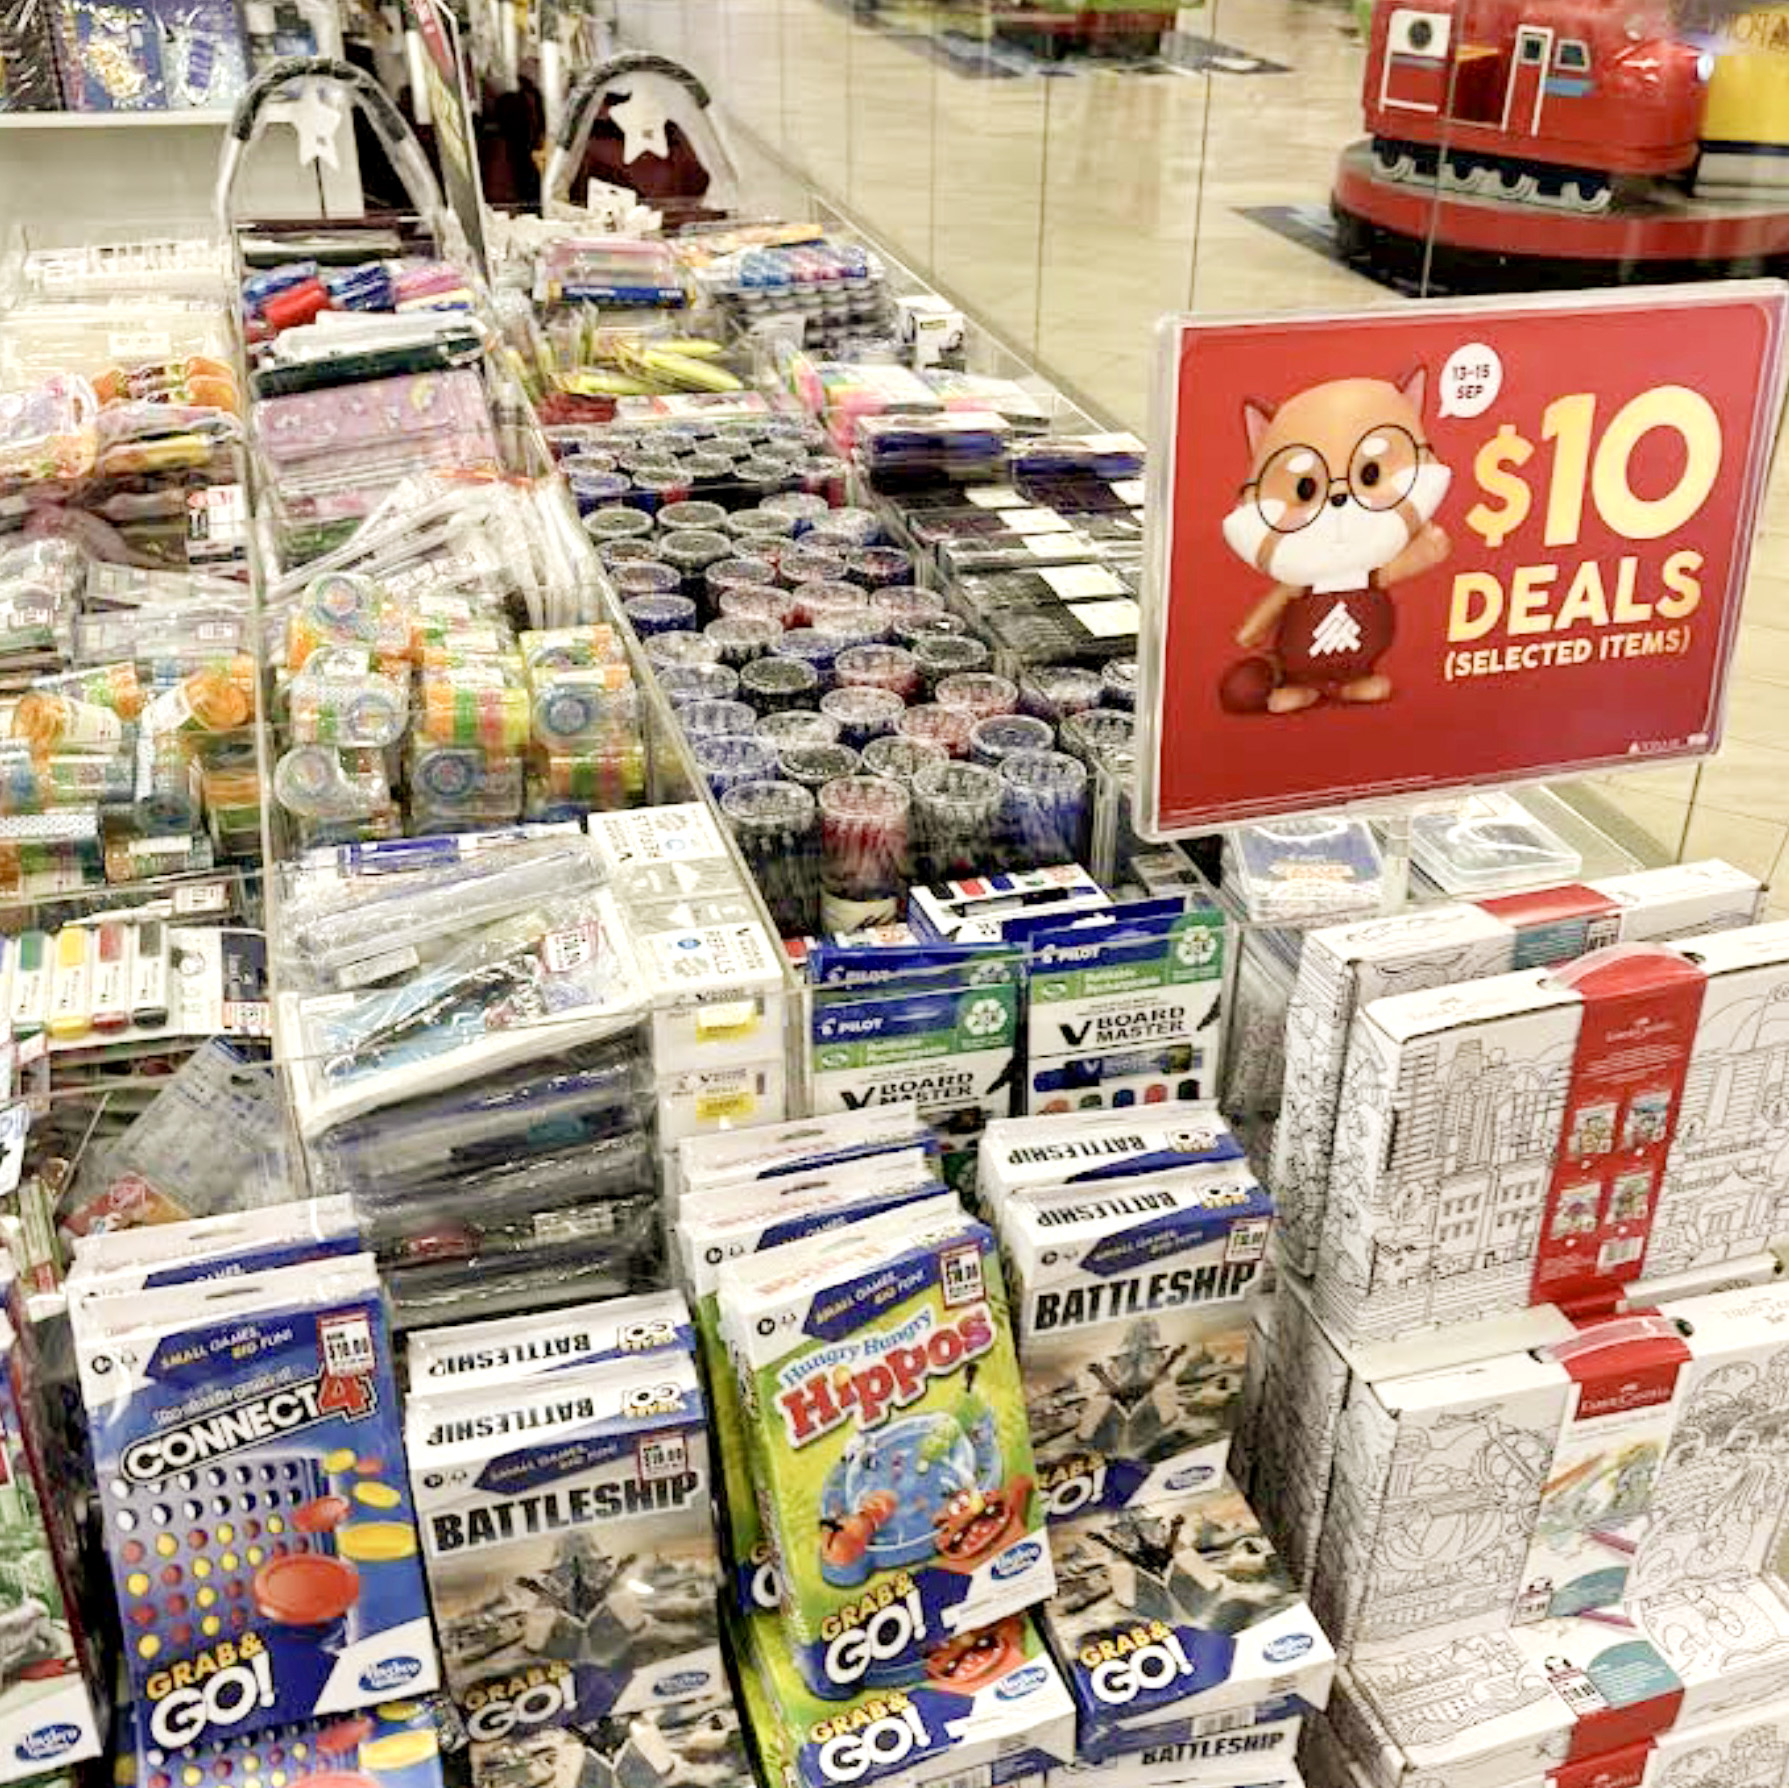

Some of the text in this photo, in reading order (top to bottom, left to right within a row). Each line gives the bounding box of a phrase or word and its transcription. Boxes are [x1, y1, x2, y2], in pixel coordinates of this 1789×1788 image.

[1457, 384, 1484, 400] SEP
[1465, 384, 1722, 548] $10
[1448, 550, 1704, 642] DEALS
[1444, 627, 1692, 681] (SELECTED ITEMS)
[838, 1017, 884, 1034] PILOT
[1059, 1020, 1093, 1046] V
[1097, 1005, 1186, 1030] BOARD
[1096, 1020, 1186, 1044] MASTER
[880, 1072, 974, 1096] BOARD
[1008, 1133, 1149, 1166] BATTLESHIP
[1036, 1190, 1179, 1228] BATTLESHIP
[1034, 1262, 1257, 1331] BATTLESHIP
[429, 1333, 591, 1377] BATTLESHIP
[781, 1309, 933, 1387] Hungry Hungry
[781, 1308, 993, 1440] Hippos
[128, 1381, 319, 1479] CONNECT
[427, 1397, 595, 1447] BATTLESHIP
[431, 1471, 700, 1551] BATTLESHIP
[821, 1580, 895, 1643] GRAB
[825, 1586, 926, 1685] GO!
[146, 1641, 238, 1700] GRAB
[1080, 1627, 1148, 1669] GRAB
[1090, 1634, 1196, 1705] GO!
[151, 1650, 276, 1749] GO!
[467, 1672, 579, 1742] GO!
[810, 1696, 891, 1746] GRAB
[818, 1703, 932, 1783] GO!
[1141, 1732, 1285, 1766] BATTLESHIP
